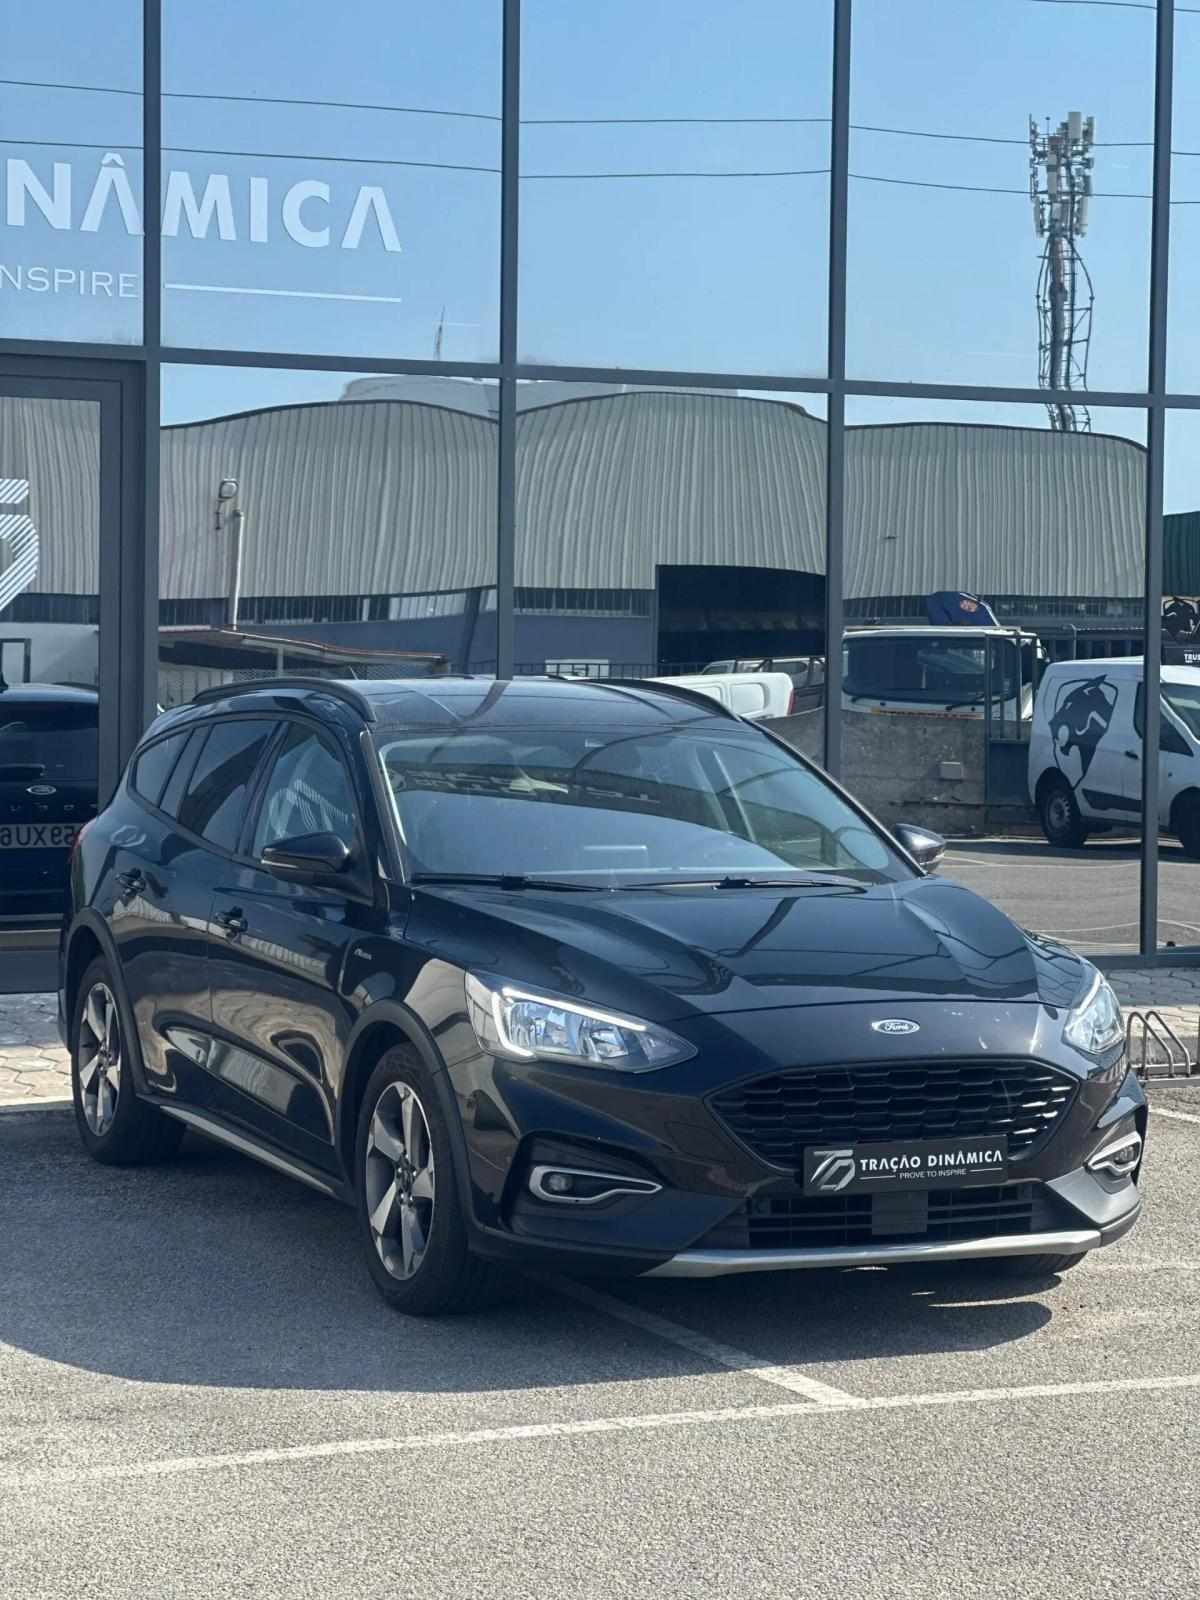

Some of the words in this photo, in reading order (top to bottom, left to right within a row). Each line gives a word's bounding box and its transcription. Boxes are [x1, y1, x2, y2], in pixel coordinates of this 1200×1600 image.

[860, 1154, 921, 1173] TRAÇÃO
[927, 1150, 1003, 1167] DINÂMICA
[900, 1171, 924, 1179] PROVE
[927, 1170, 937, 1178] TO
[938, 1168, 967, 1176] INSPIRE
